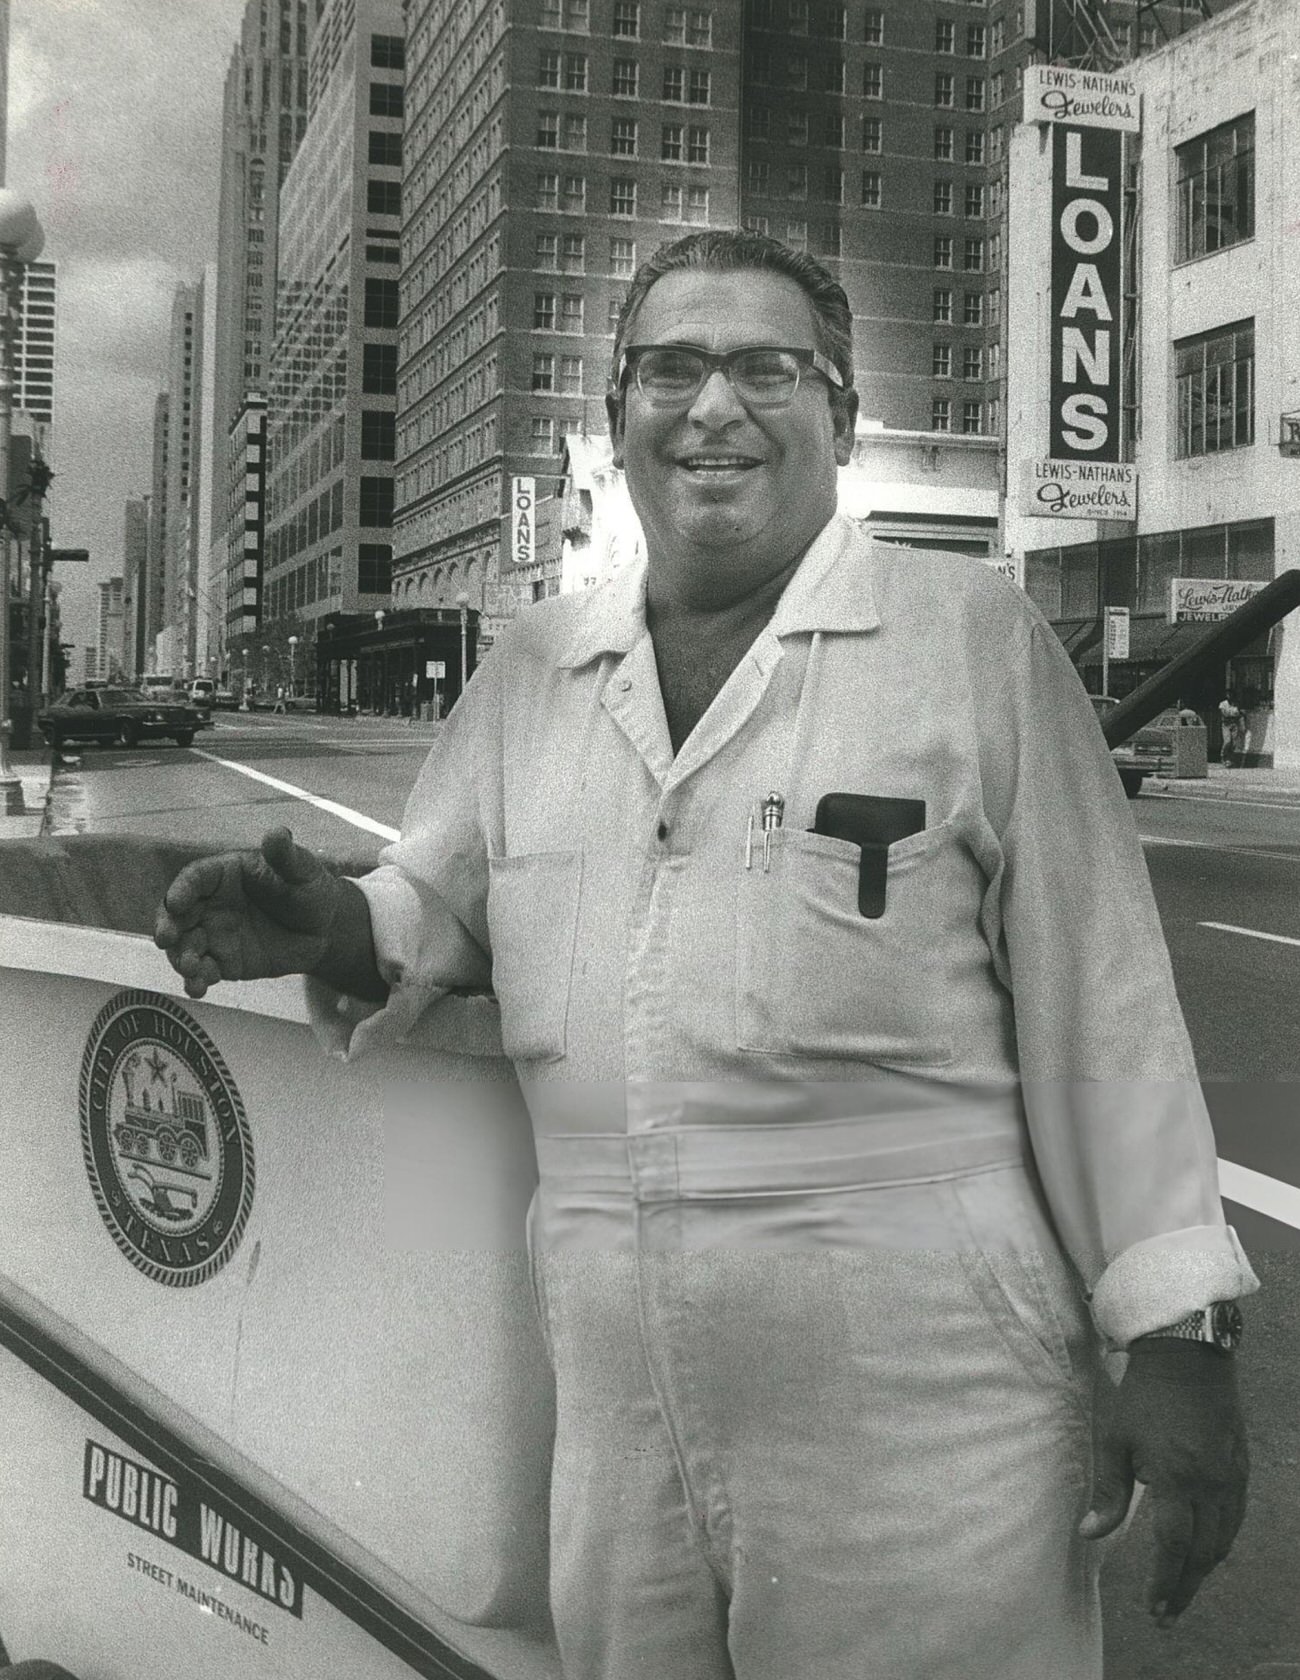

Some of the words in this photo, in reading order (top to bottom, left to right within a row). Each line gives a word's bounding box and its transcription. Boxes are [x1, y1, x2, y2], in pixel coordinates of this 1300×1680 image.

[1041, 90, 1135, 119] Jewelers
[1060, 131, 1114, 451] LOANS
[517, 478, 532, 561] LOANS
[1036, 482, 1131, 513] Jewelers
[89, 1445, 179, 1539] PUBLIC
[127, 1552, 175, 1588] STREET
[177, 1577, 269, 1646] MAINTENANCE
